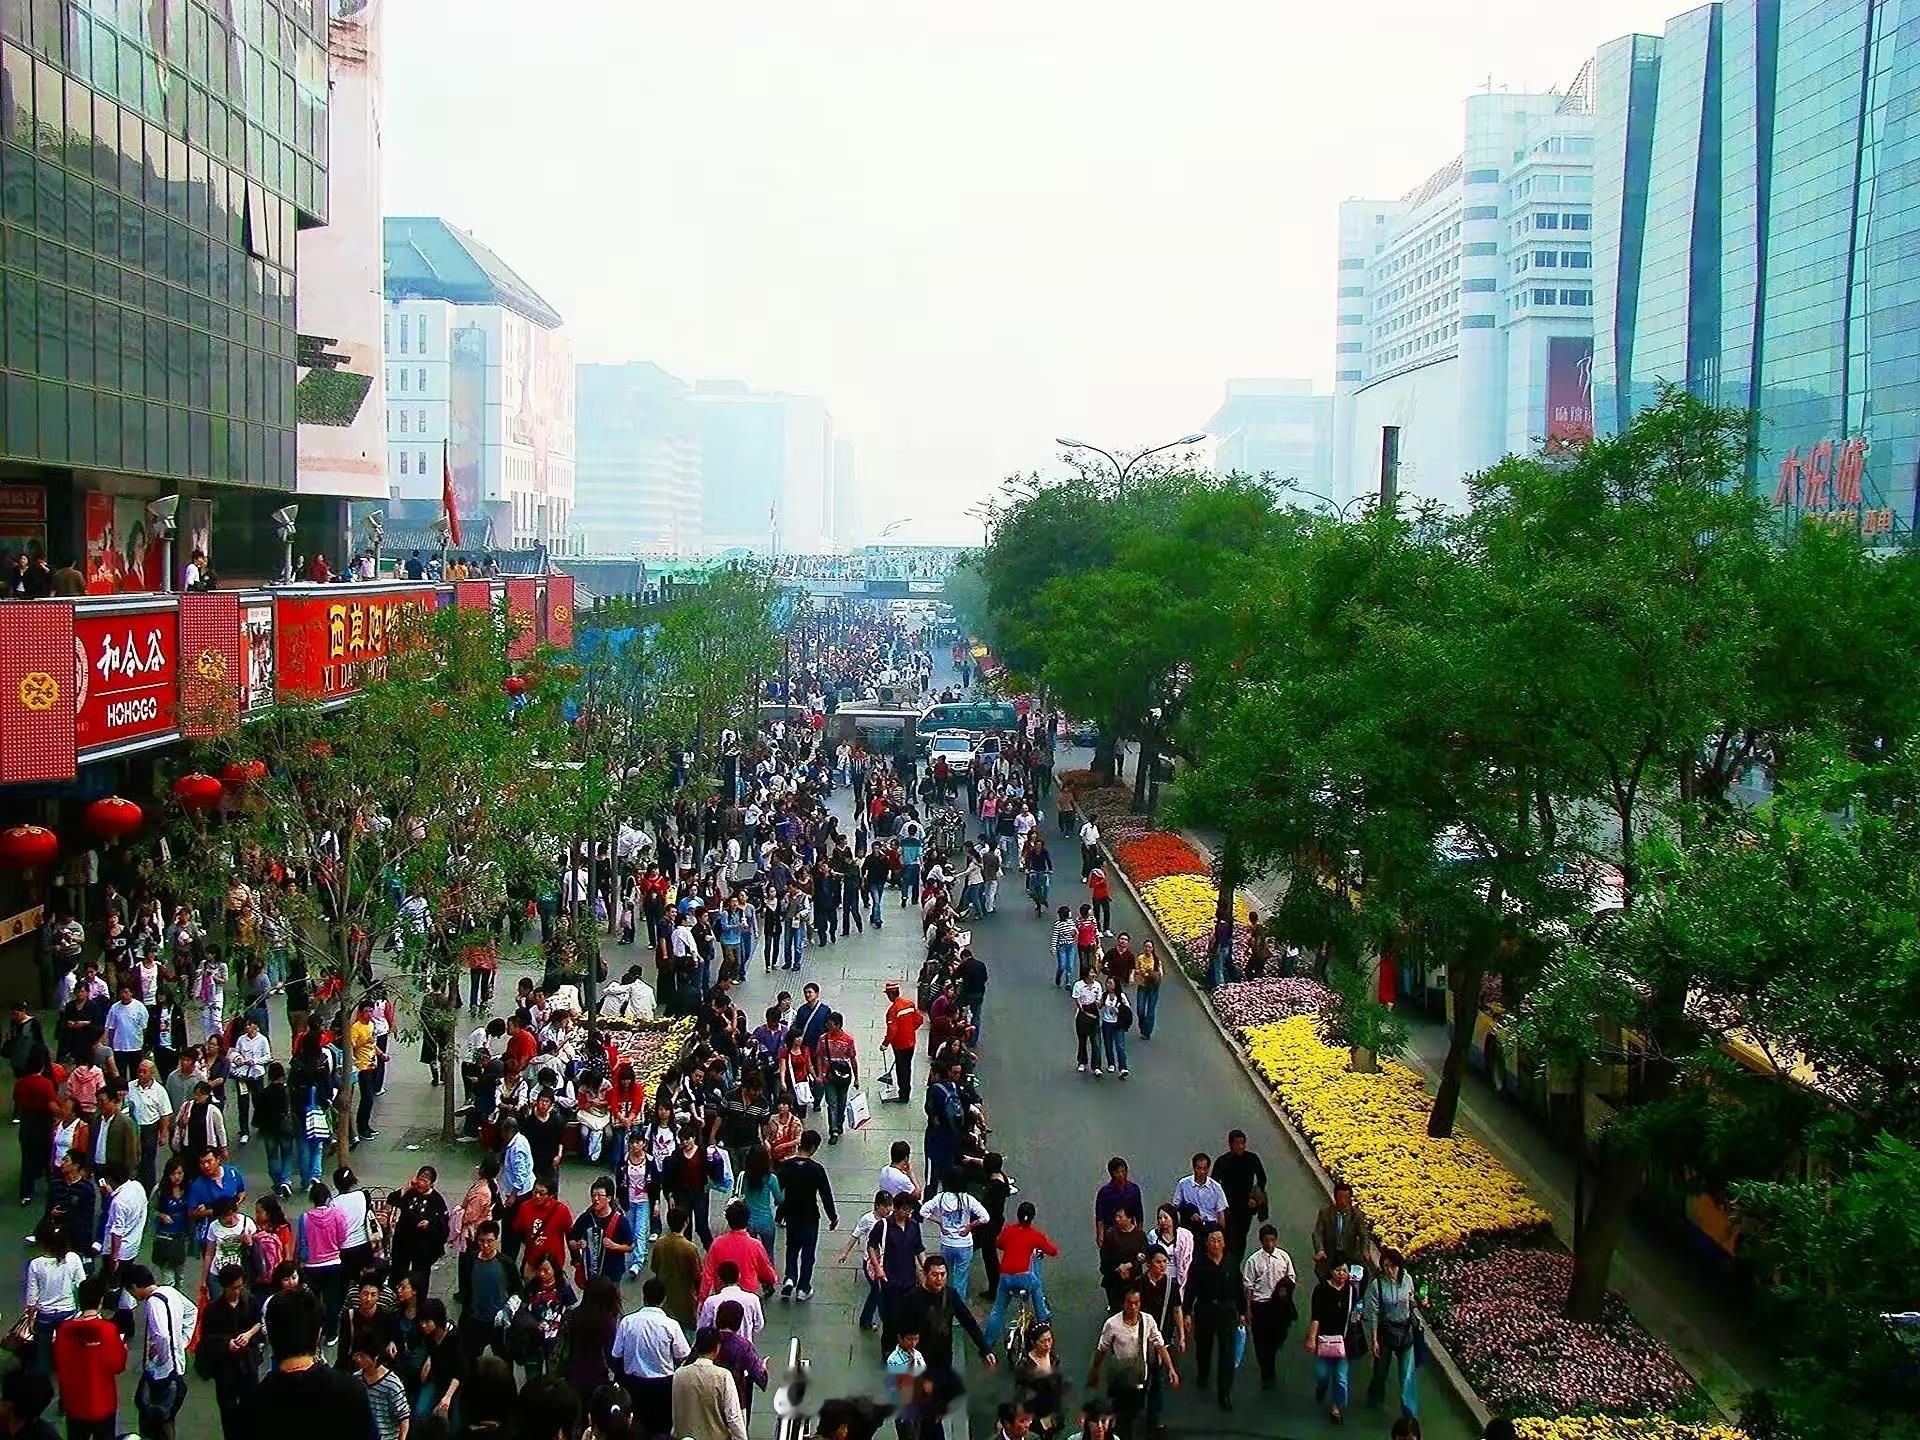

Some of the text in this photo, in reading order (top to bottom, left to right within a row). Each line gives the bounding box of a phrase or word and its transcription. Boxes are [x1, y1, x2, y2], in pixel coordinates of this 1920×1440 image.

[96, 628, 167, 683] 和合谷
[107, 696, 157, 729] HOHOGO
